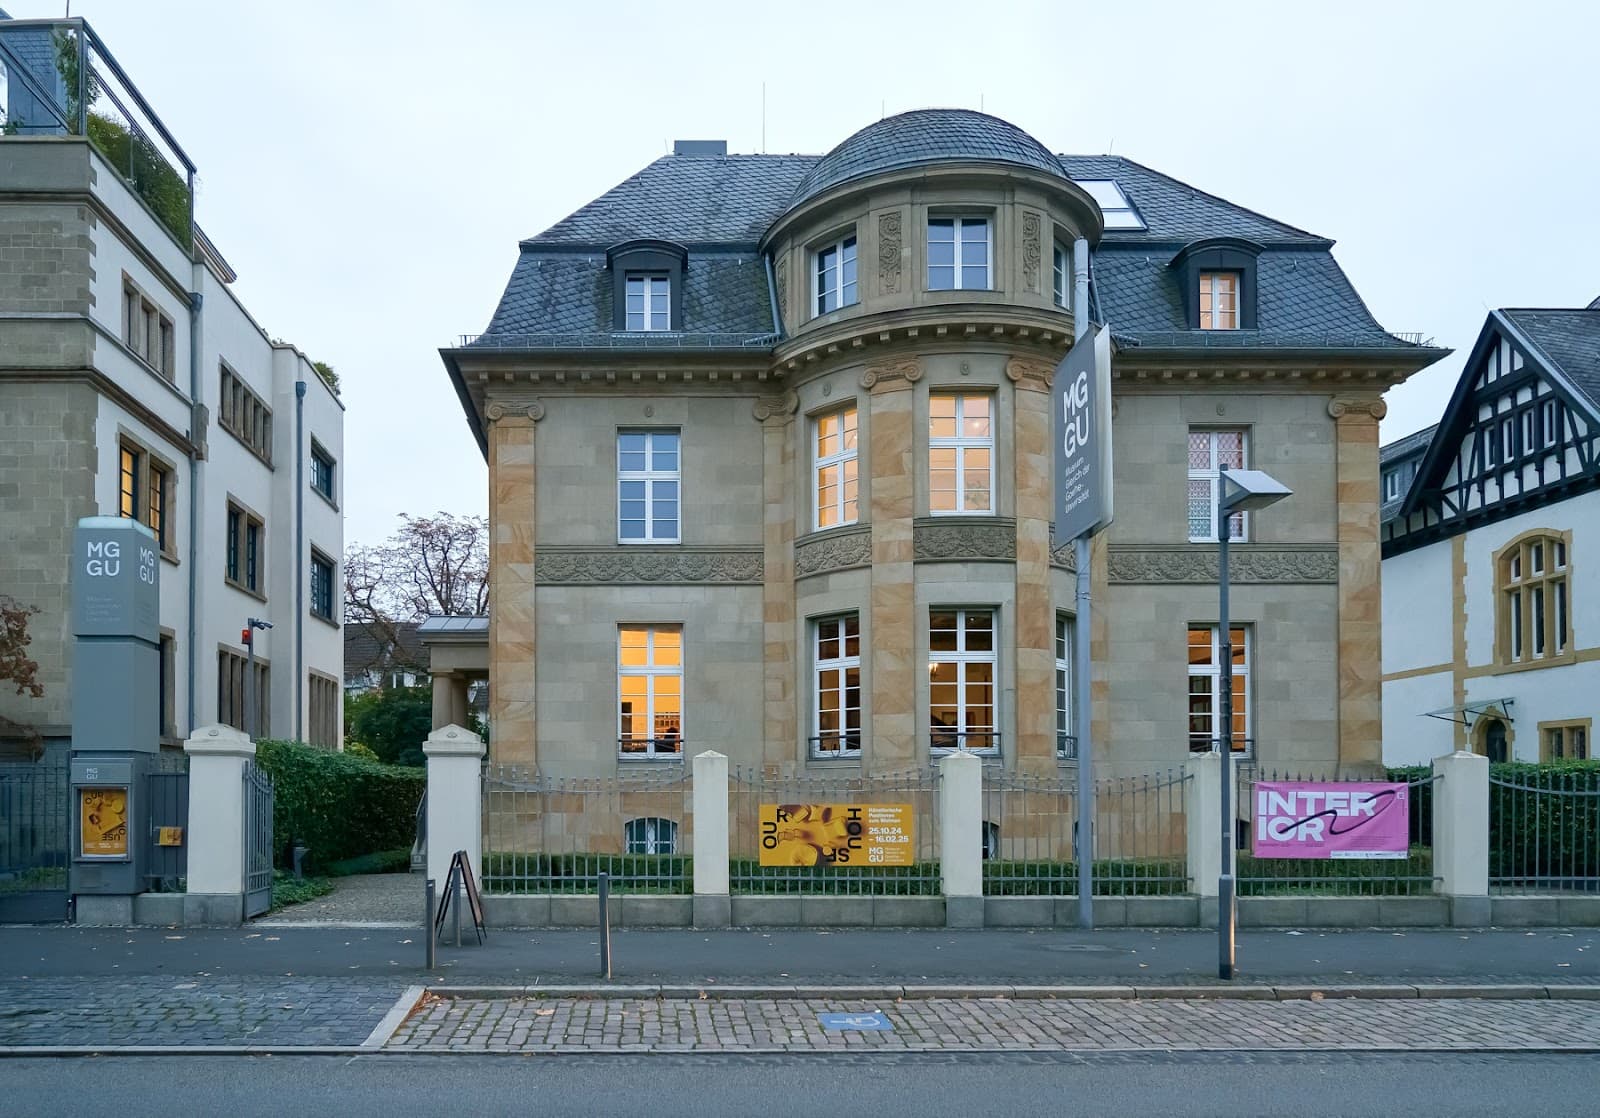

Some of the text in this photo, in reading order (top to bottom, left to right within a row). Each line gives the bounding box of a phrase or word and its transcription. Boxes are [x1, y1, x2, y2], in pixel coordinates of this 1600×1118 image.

[1063, 371, 1088, 424] MG
[1064, 407, 1089, 458] GU
[87, 541, 120, 558] MG
[140, 546, 154, 567] MG
[86, 560, 120, 577] GU
[139, 566, 154, 585] GU
[1258, 791, 1377, 817] INTER
[868, 827, 902, 835] 25.10.24
[1258, 816, 1325, 842] IOR
[875, 835, 909, 843] 16.02.25
[868, 847, 884, 855] MG
